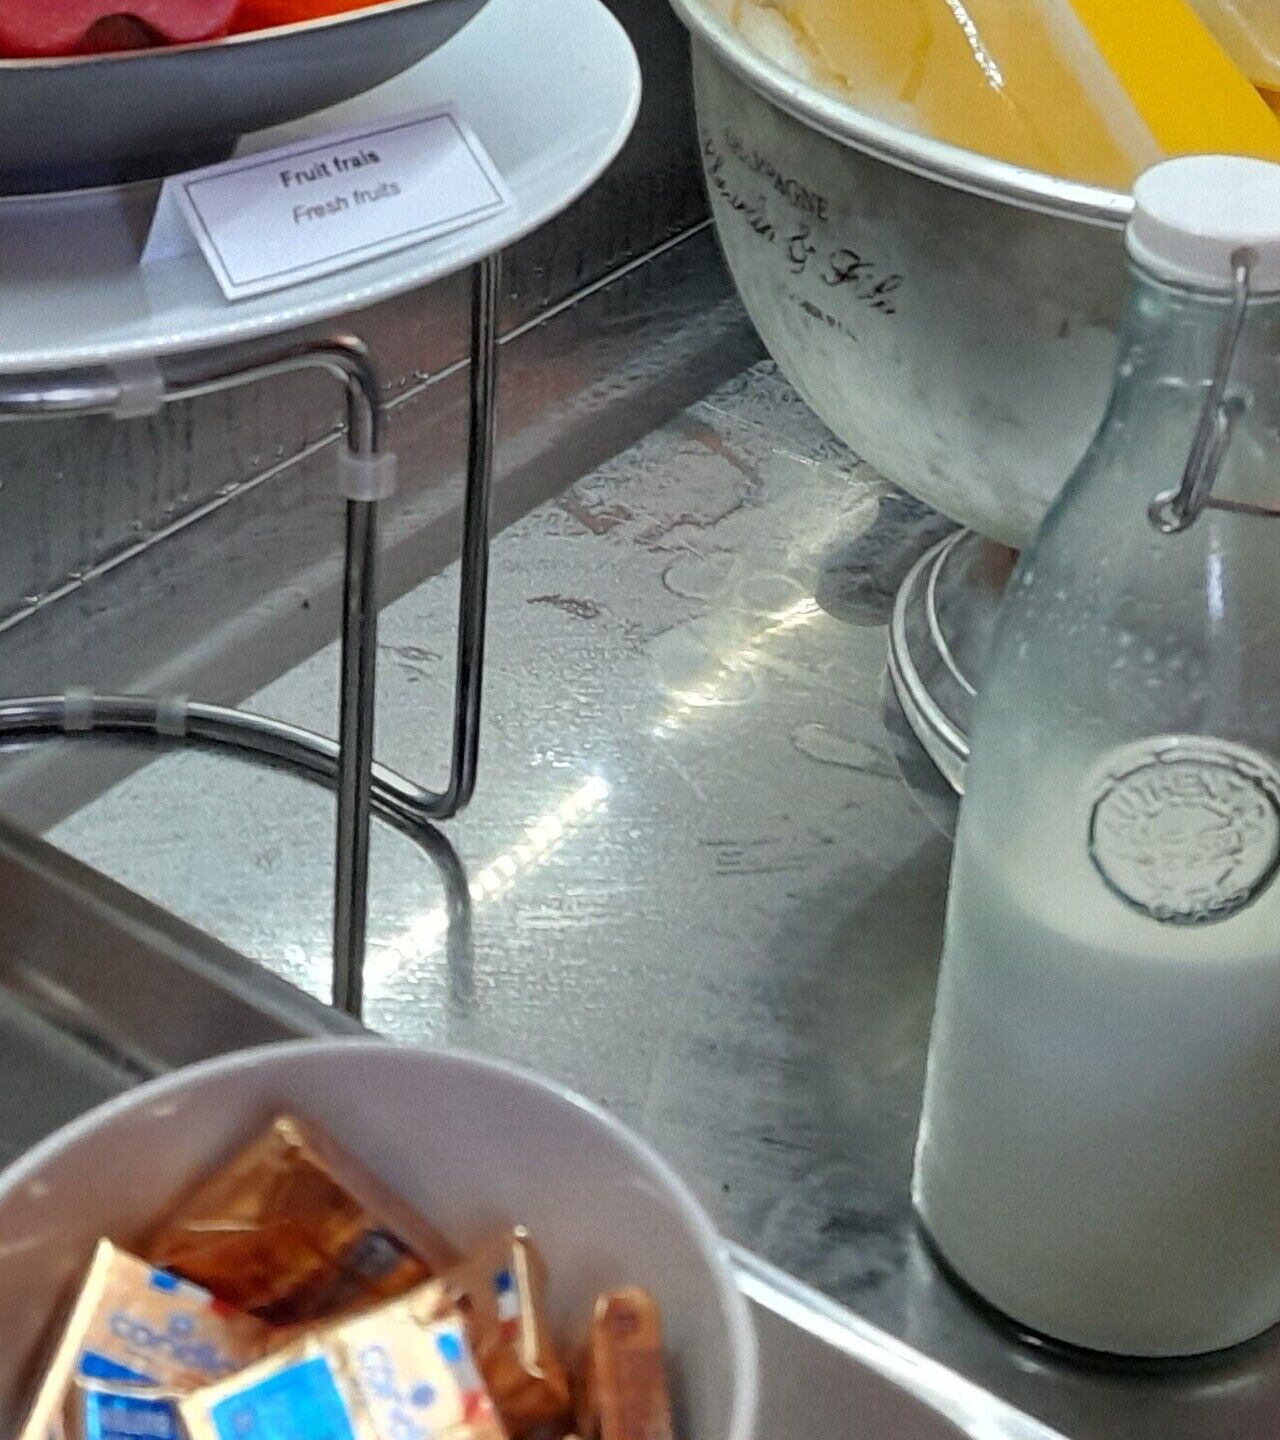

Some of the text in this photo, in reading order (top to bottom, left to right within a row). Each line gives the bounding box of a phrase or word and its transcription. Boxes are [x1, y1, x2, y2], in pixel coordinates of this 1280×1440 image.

[279, 148, 380, 188] Fruit frais
[291, 180, 400, 225] Fresh fruits
